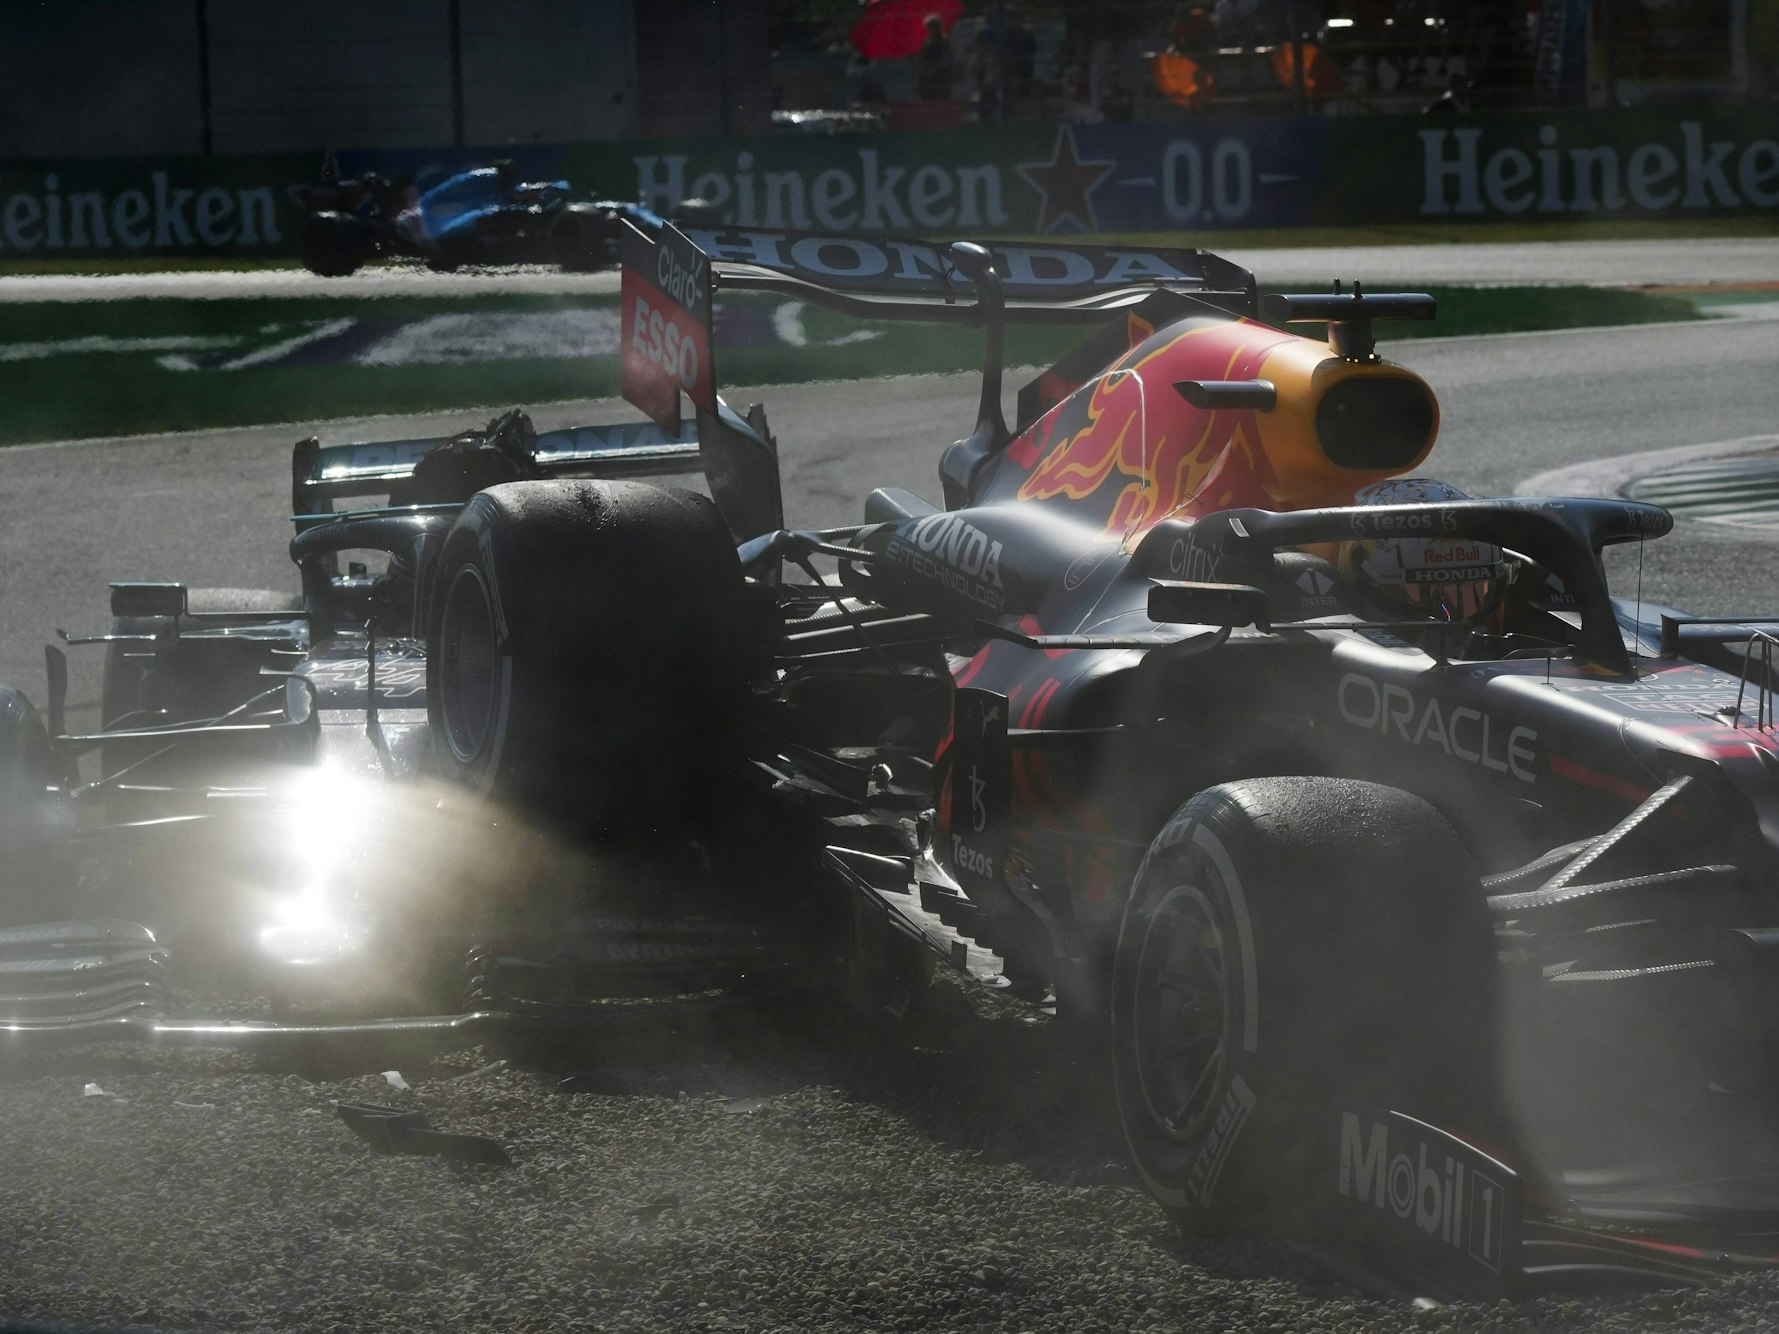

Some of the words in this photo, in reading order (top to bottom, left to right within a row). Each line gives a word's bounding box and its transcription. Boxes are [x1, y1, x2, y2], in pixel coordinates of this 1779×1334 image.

[0, 169, 282, 253] eineken
[1163, 136, 1254, 223] 0.0
[658, 245, 697, 310] Claro
[690, 231, 1187, 287] HONDA
[633, 296, 699, 390] ESSO
[893, 512, 1005, 590] HONDA
[1372, 512, 1432, 529] Tezos
[1414, 566, 1492, 582] HONDA
[1423, 548, 1454, 564] Red
[1455, 546, 1480, 562] Bull
[1300, 596, 1338, 607] INTER
[1337, 673, 1538, 784] ORACLE
[952, 834, 994, 880] Tezos
[1338, 1111, 1464, 1249] Mobil
[1482, 1186, 1493, 1260] 1
